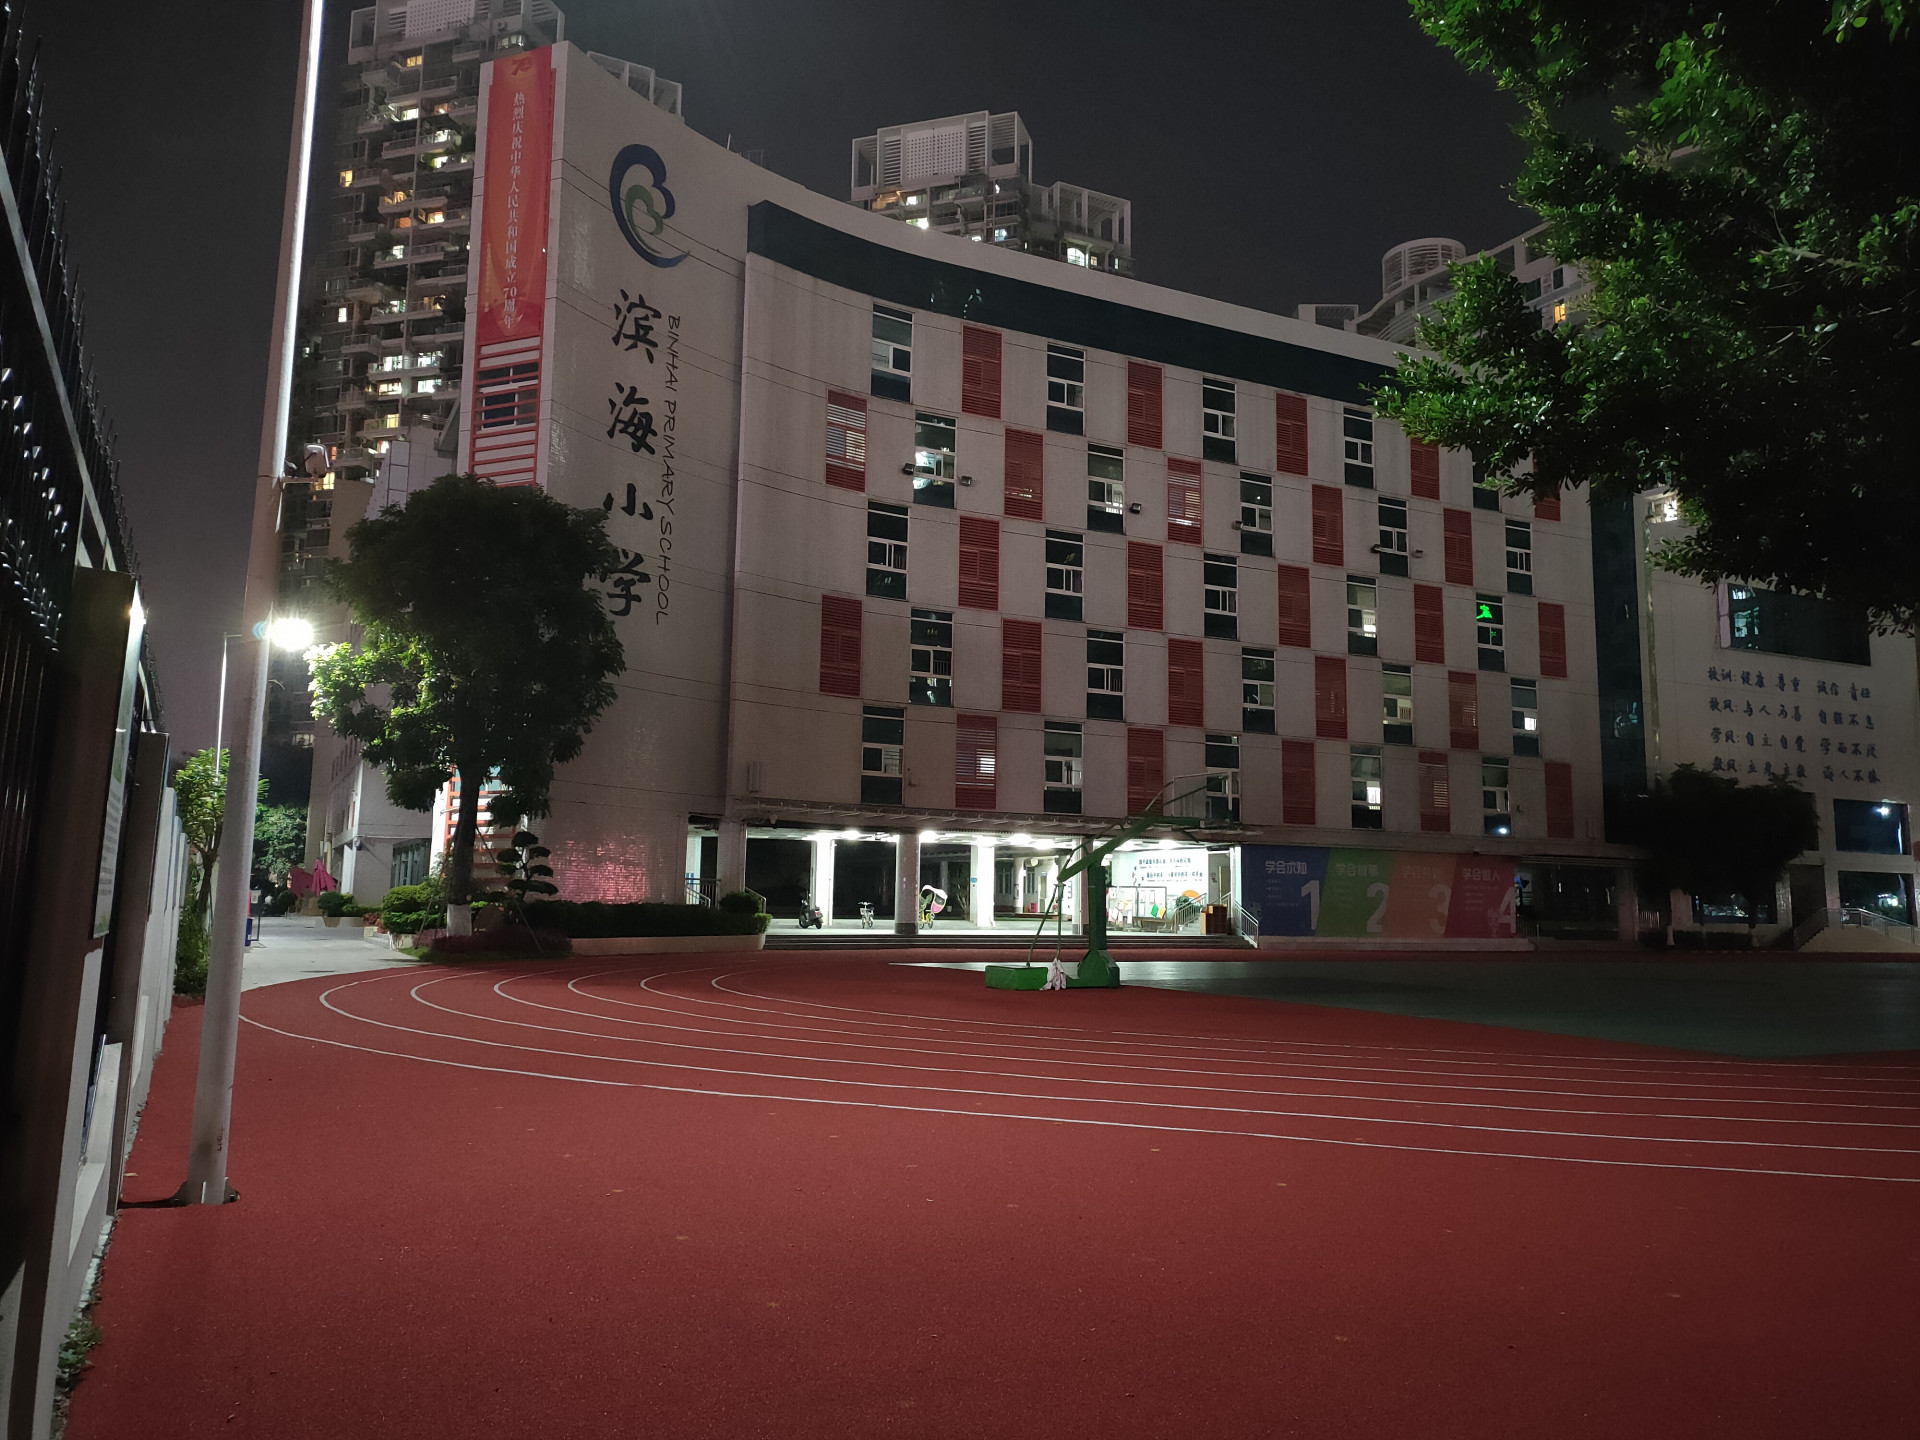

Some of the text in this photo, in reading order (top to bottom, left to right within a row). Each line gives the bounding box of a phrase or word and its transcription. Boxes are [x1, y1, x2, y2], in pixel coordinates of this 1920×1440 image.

[503, 91, 526, 329] 热烈庆祝中华人民共和国成立70周年
[598, 288, 663, 618] 滨海小学
[655, 314, 681, 626] BINHAI PRIMARY SCHOOL
[1264, 860, 1308, 875] 学会求知
[1301, 880, 1320, 931] 1
[1366, 882, 1390, 933] 2
[1428, 885, 1452, 935] 3
[1498, 886, 1516, 934] 4
